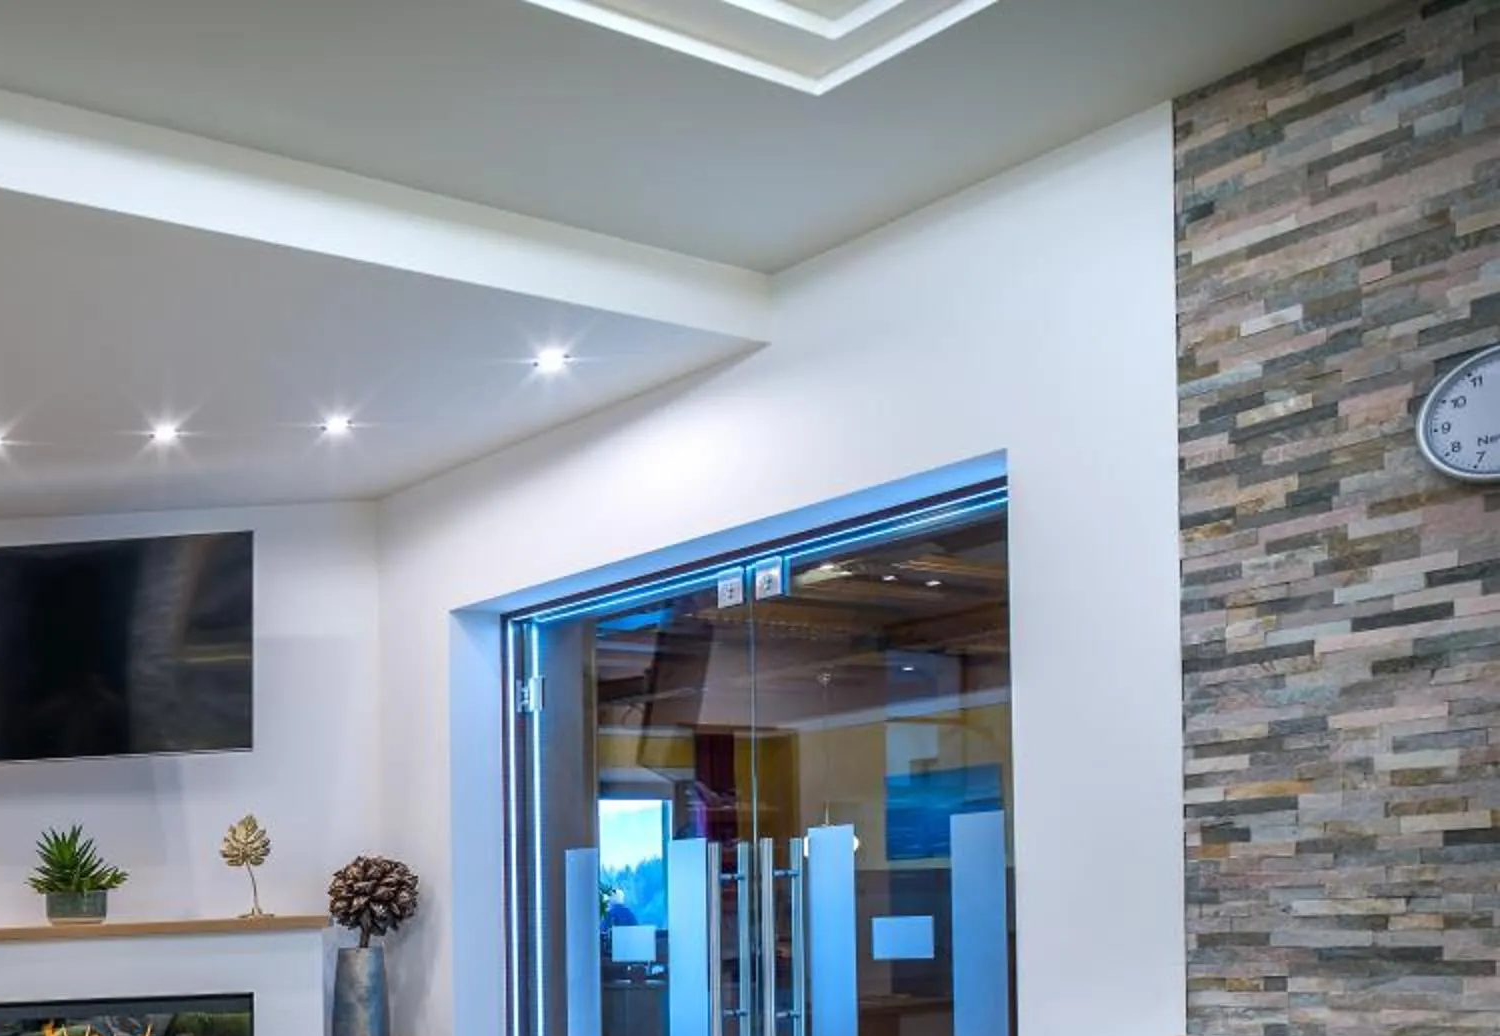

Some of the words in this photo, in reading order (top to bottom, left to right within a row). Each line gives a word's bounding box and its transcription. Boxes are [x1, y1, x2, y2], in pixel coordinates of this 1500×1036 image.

[1470, 375, 1483, 388] 11
[1451, 396, 1467, 408] 10
[1442, 422, 1451, 435] 9
[1451, 441, 1462, 453] 8
[1476, 451, 1486, 463] 7
